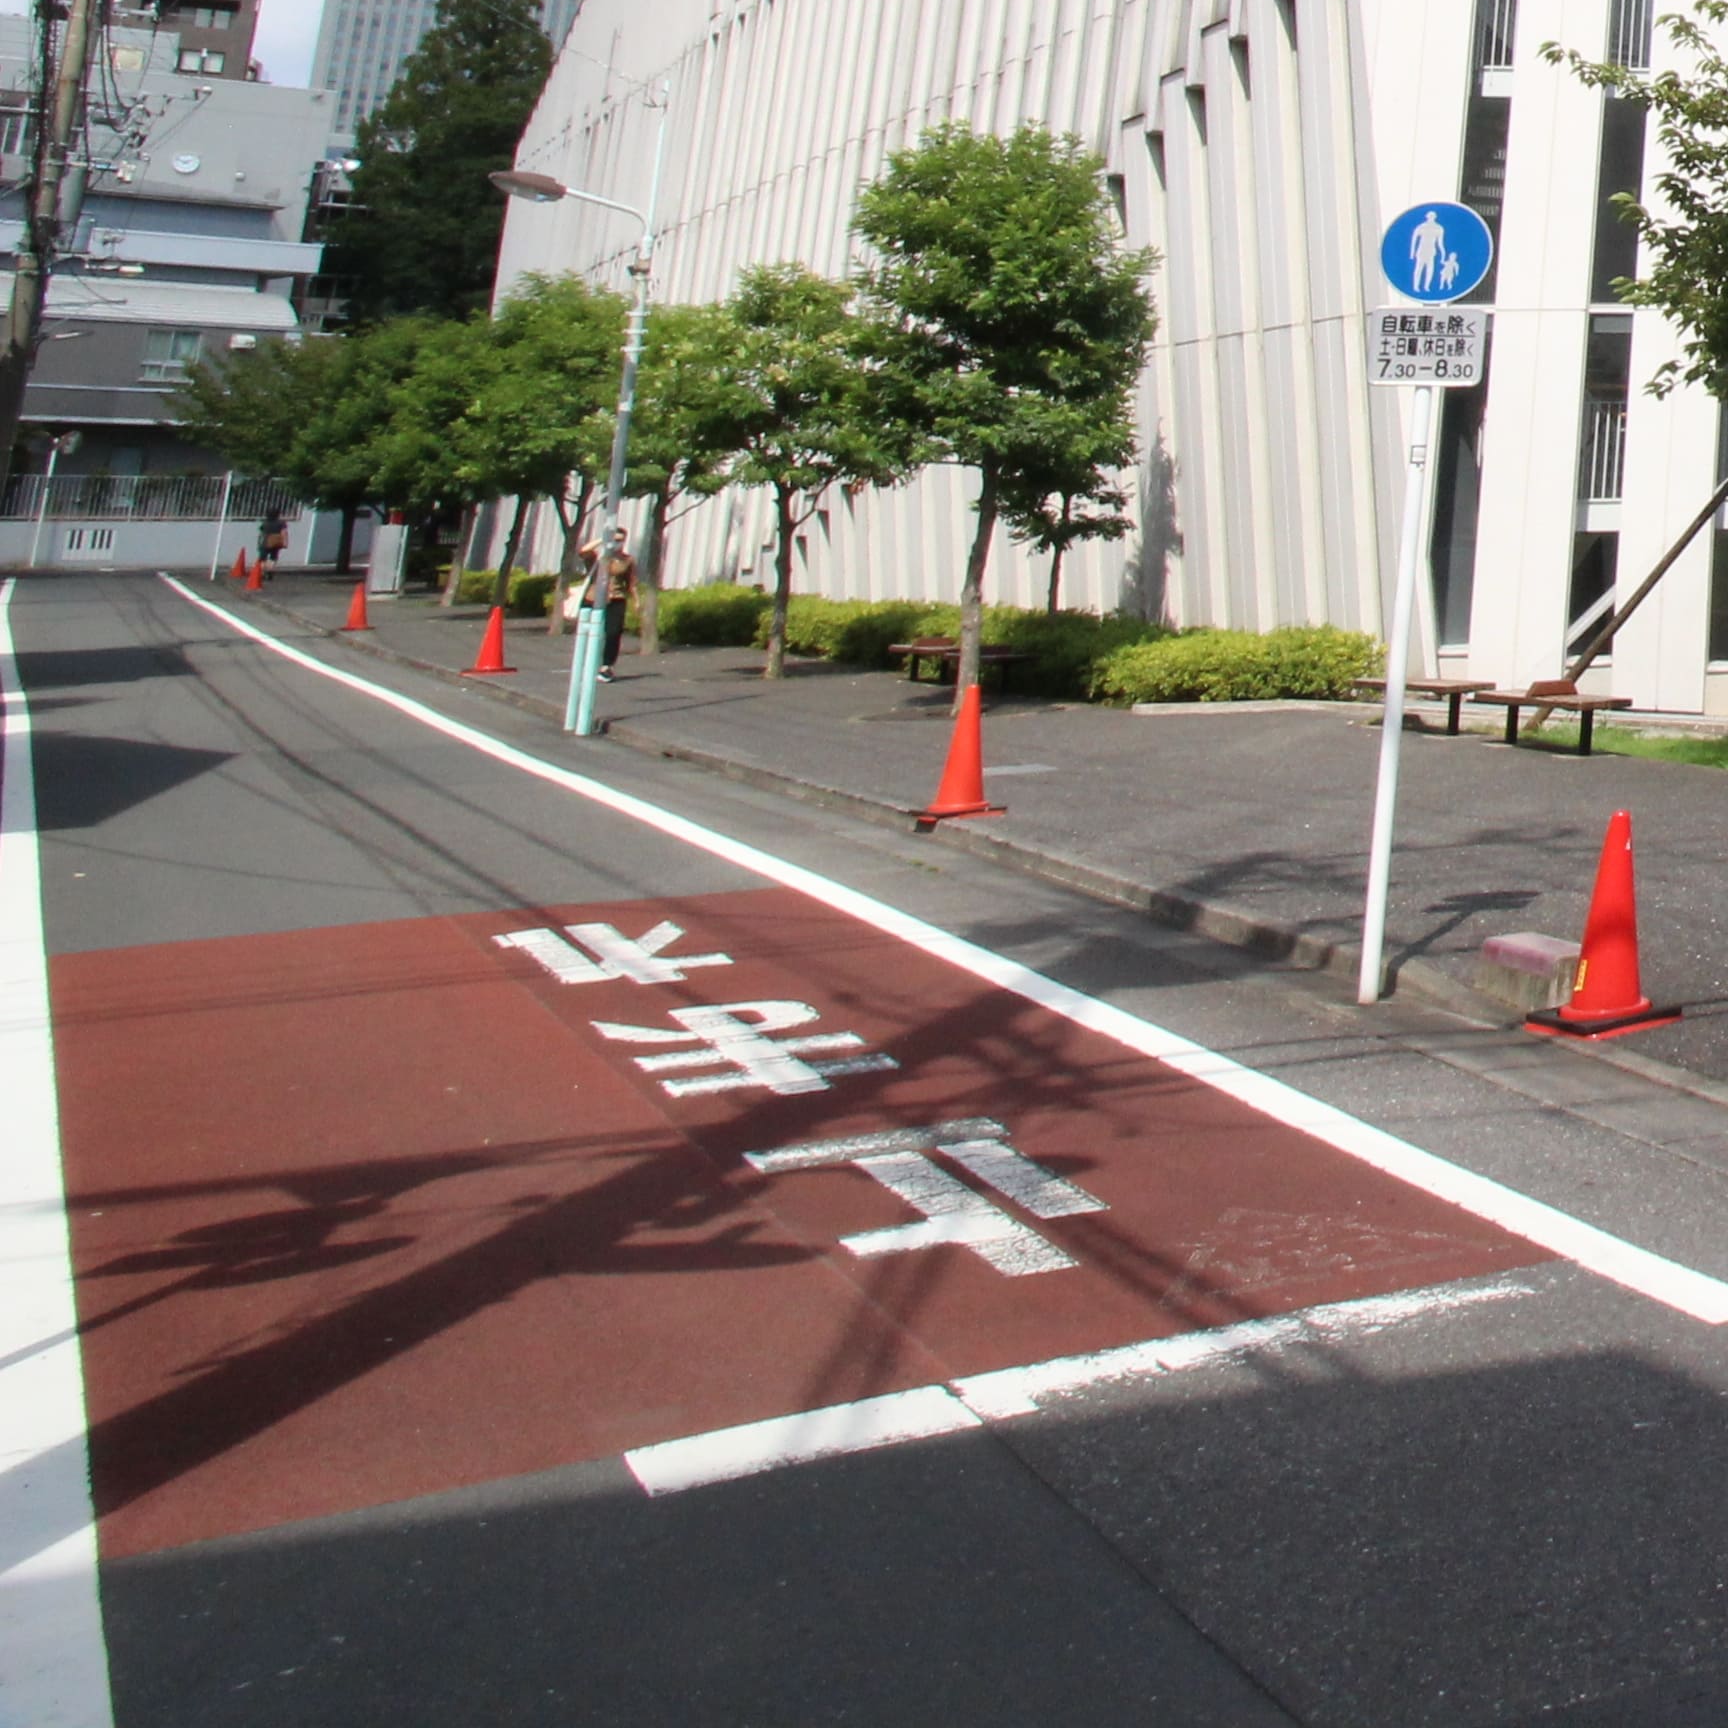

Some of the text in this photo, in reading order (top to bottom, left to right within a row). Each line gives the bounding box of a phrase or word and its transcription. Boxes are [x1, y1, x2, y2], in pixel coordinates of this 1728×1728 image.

[1381, 314, 1476, 334] 自転車を除く
[491, 919, 1110, 1277] 止まれ
